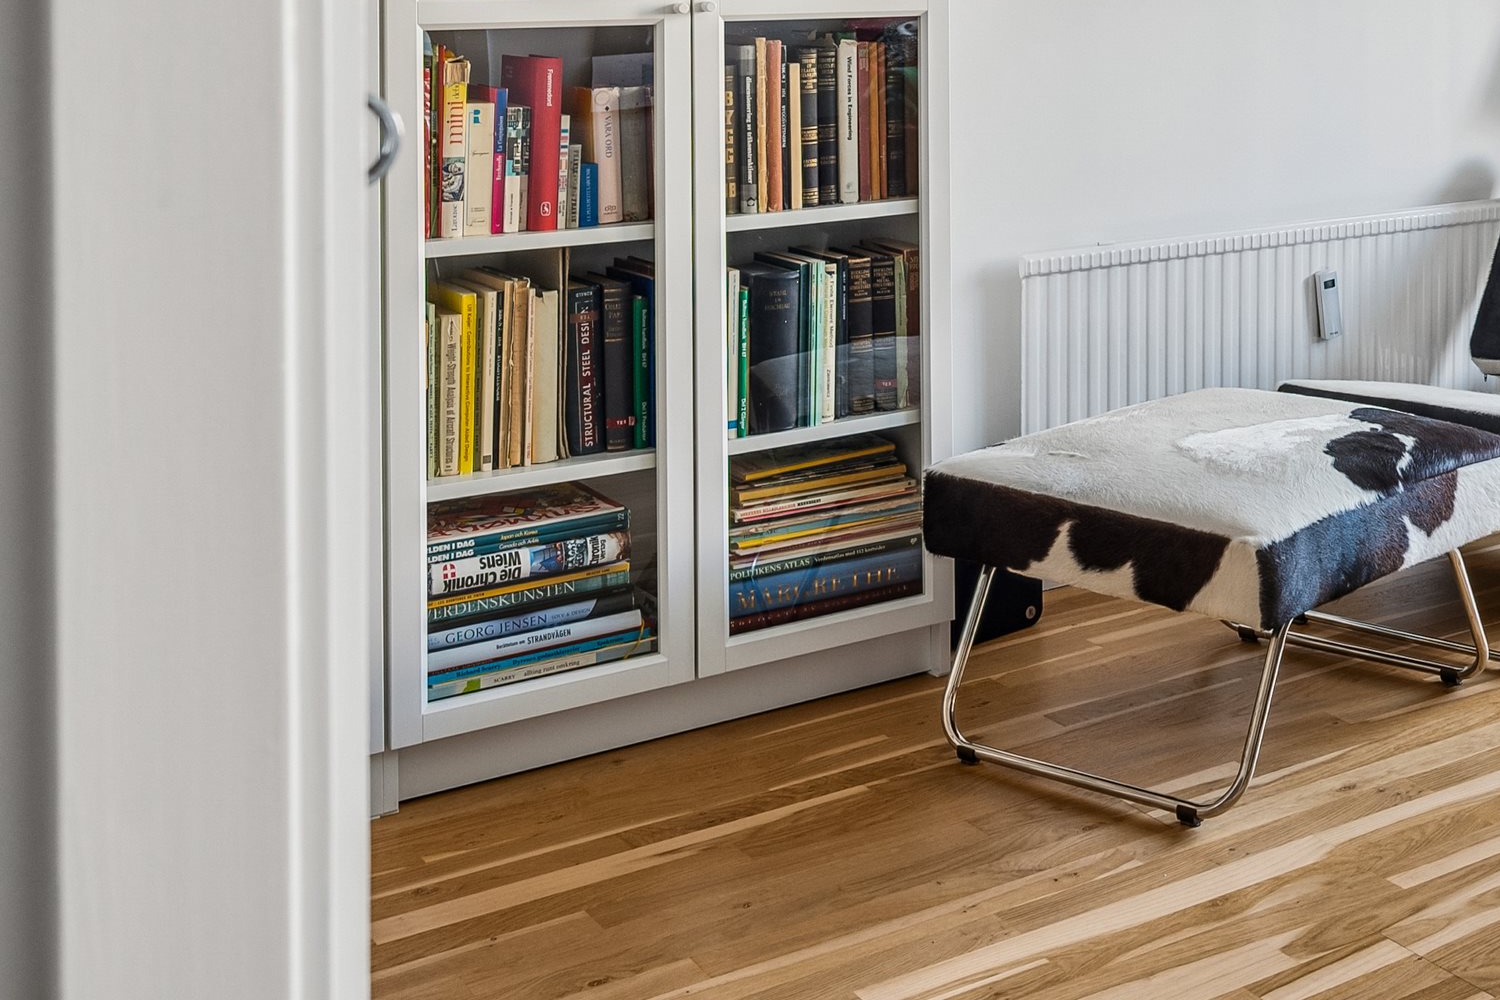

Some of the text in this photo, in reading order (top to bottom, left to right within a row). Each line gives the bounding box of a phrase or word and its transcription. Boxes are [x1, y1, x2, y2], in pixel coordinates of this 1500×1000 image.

[446, 102, 464, 144] mini
[604, 140, 612, 158] ORD
[465, 331, 473, 366] Contributions
[447, 343, 457, 385] Weight-Strength
[446, 387, 457, 408] Analysis
[581, 350, 594, 447] STRUCTURAL STEEL
[445, 416, 456, 437] Aircraft
[445, 438, 455, 464] Structures
[456, 539, 475, 549] DAG
[618, 512, 624, 521] 22
[455, 549, 474, 559] DAG
[479, 550, 522, 570] Wiens
[443, 566, 521, 592] Die Chronik
[730, 563, 782, 581] POLITIKENS
[784, 558, 811, 570] ATLAS
[445, 625, 494, 644] GEORG
[499, 614, 547, 633] JENSEN
[571, 607, 590, 616] DESIGN
[527, 628, 571, 645] STRANDVÄGEN
[494, 674, 515, 683] SCARRY
